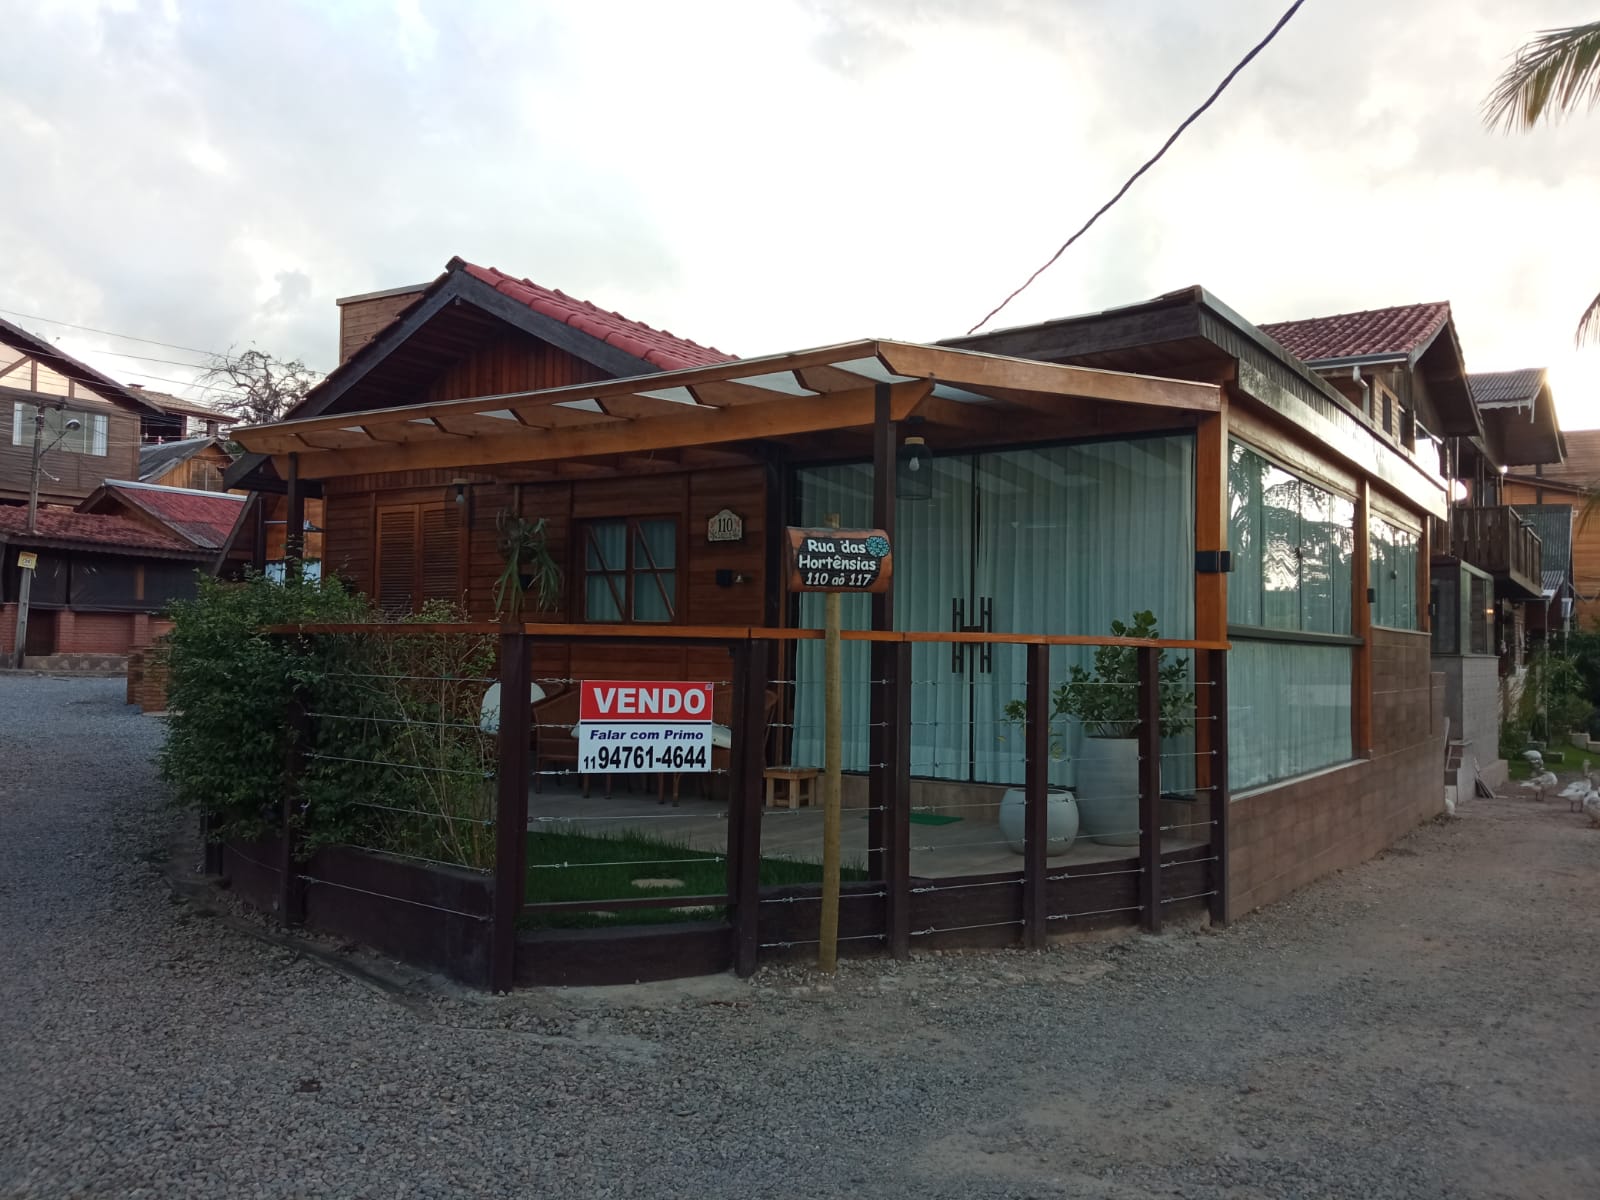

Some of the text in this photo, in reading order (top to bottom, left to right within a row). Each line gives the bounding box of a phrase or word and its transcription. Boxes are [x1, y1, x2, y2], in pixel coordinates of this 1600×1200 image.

[718, 517, 733, 532] 110
[807, 539, 866, 554] Rua das
[798, 555, 877, 571] Hortênsias
[805, 572, 829, 585] 110
[848, 573, 872, 586] 117
[593, 687, 706, 714] VENDO
[590, 730, 704, 740] Falar com Primo
[583, 745, 706, 769] 11 94761-4644
